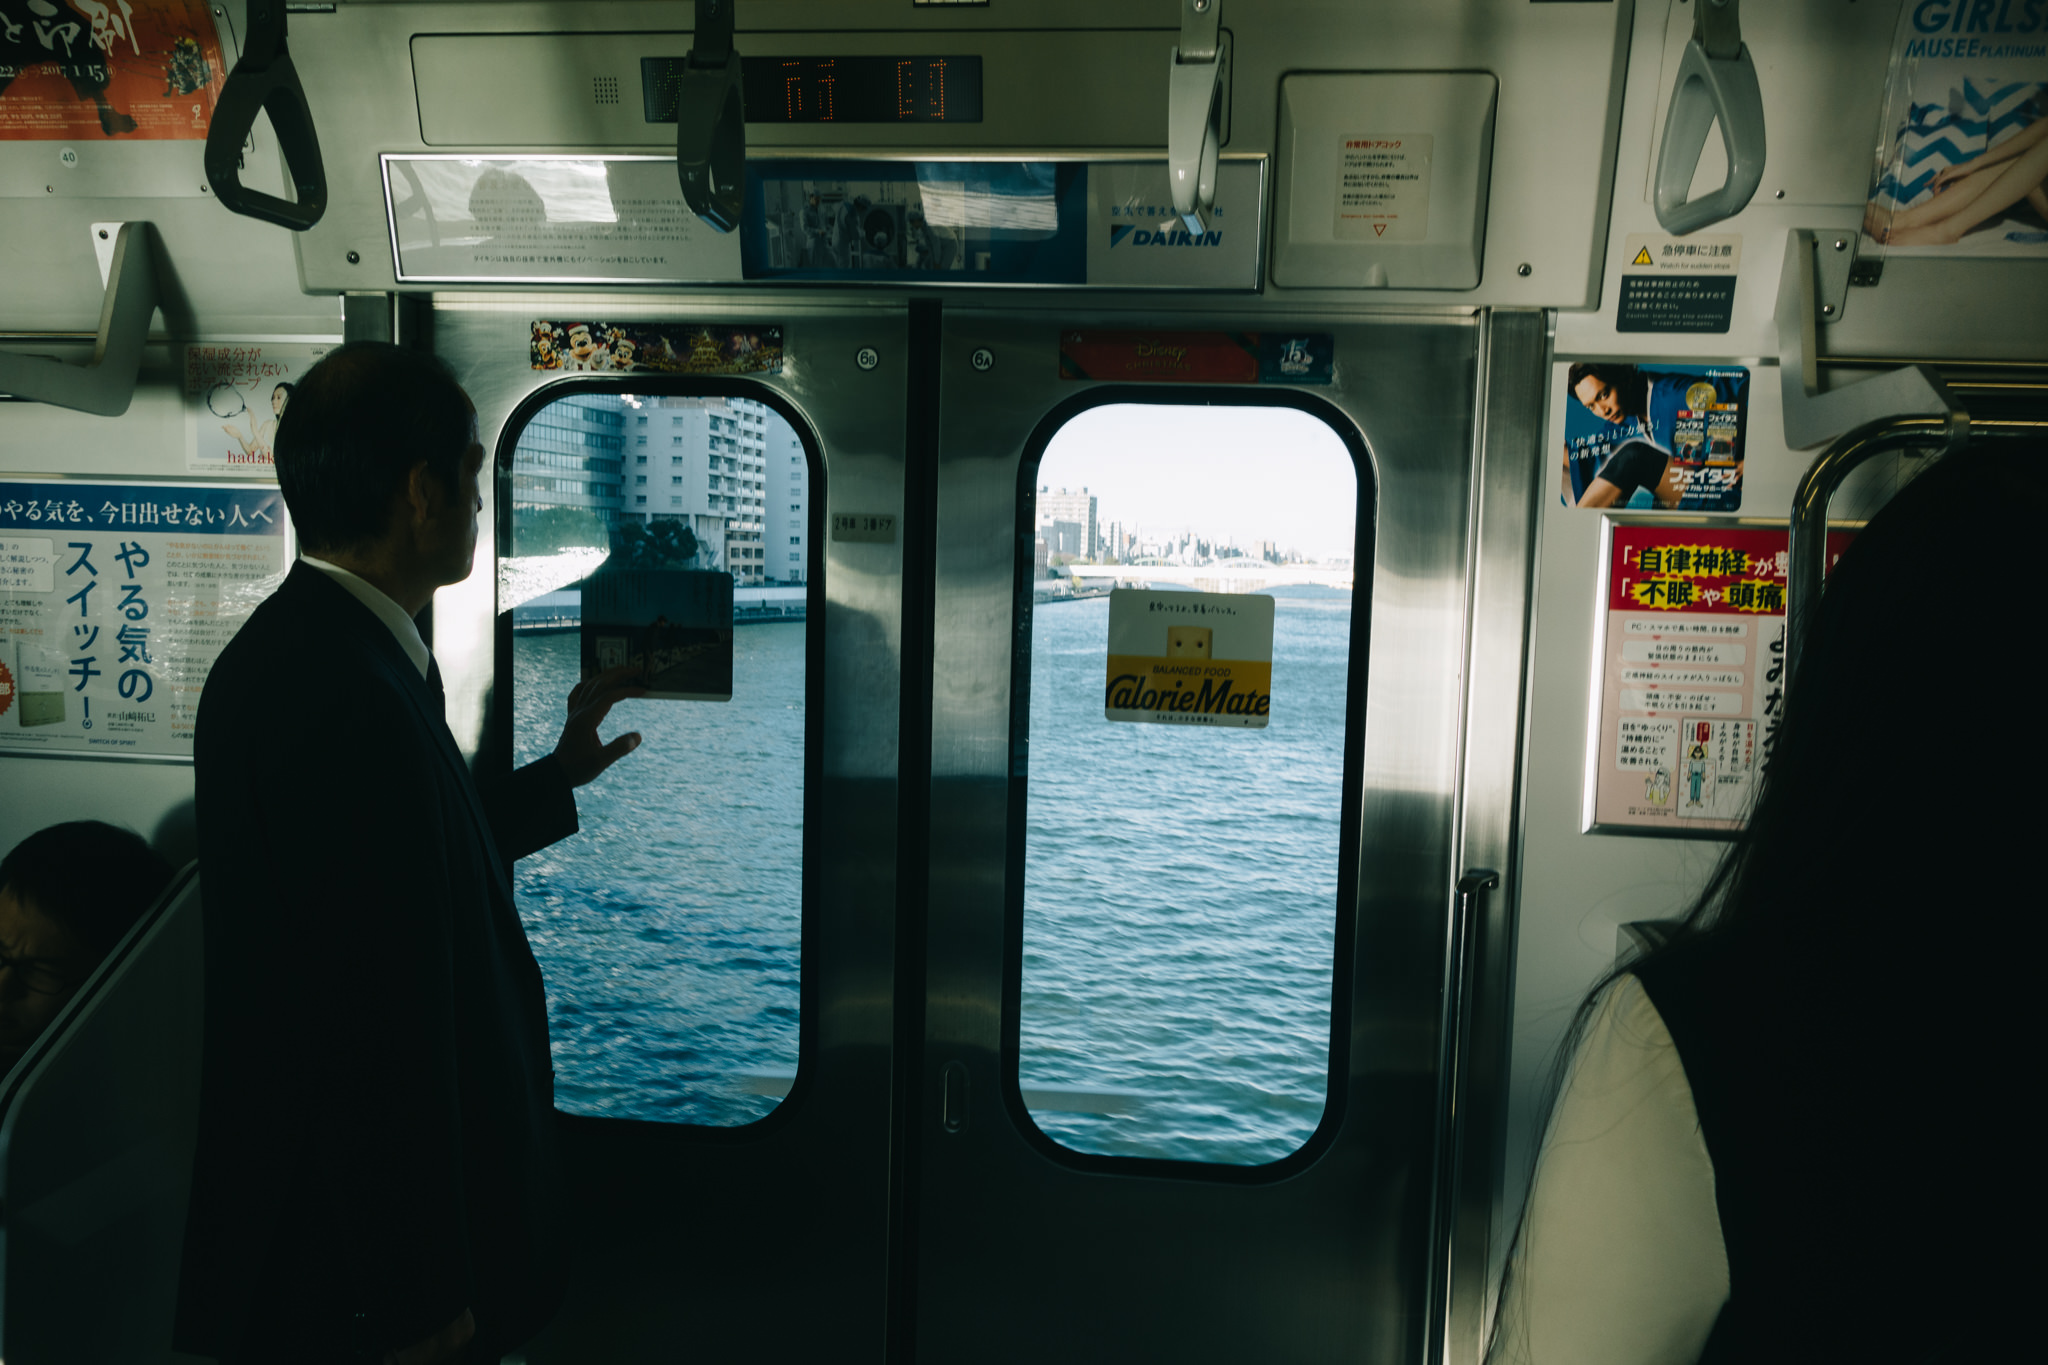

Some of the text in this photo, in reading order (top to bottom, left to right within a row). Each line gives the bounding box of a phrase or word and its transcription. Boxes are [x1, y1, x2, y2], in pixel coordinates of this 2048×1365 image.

[1906, 38, 2046, 57] MUSEE PLATINUM
[62, 152, 75, 163] 40
[1132, 230, 1223, 246] DAIKIN
[1661, 244, 1733, 257] 急停車に注意
[1679, 262, 1689, 270] for
[188, 347, 261, 361] 保湿成分が
[860, 351, 876, 366] 6B
[1133, 342, 1188, 362] Disney
[974, 352, 991, 367] 6A
[188, 362, 289, 376] 洗い流されない
[1669, 467, 1738, 485] フェイタス
[115, 540, 154, 703] やる気の
[1152, 664, 1232, 678] BALANCED FOOD
[1105, 674, 1270, 716] CalorieMate
[88, 737, 110, 745] SWITCH
[1620, 745, 1666, 755] 温めることで
[1620, 757, 1663, 766] 改善される。
